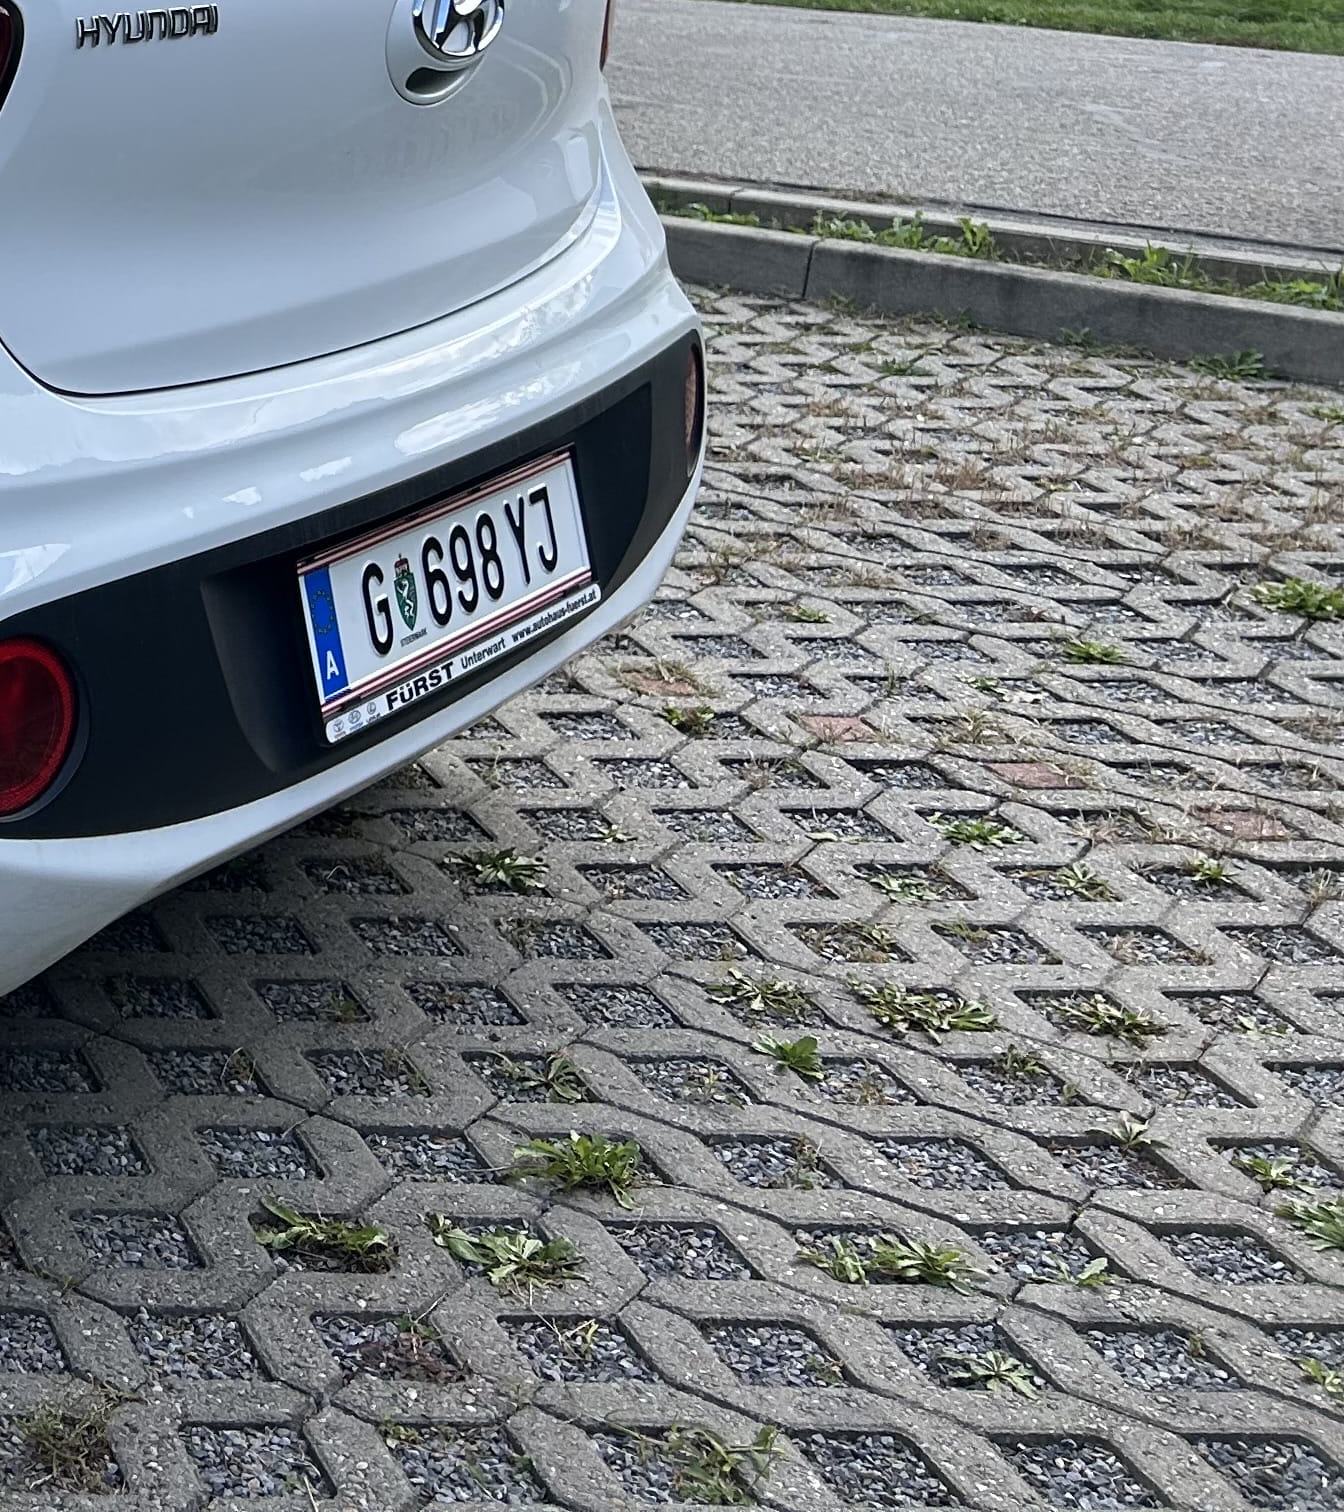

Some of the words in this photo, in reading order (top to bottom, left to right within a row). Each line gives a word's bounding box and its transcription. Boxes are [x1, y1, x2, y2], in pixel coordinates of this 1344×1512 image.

[76, 3, 218, 49] HYUNDAI
[361, 562, 394, 656] G
[421, 512, 505, 627] 698
[503, 485, 558, 585] YJ
[325, 649, 340, 681] A
[385, 661, 454, 711] FÜRST
[461, 637, 507, 670] Unterwart
[511, 588, 597, 643] www.autohaus-fuerst.at
